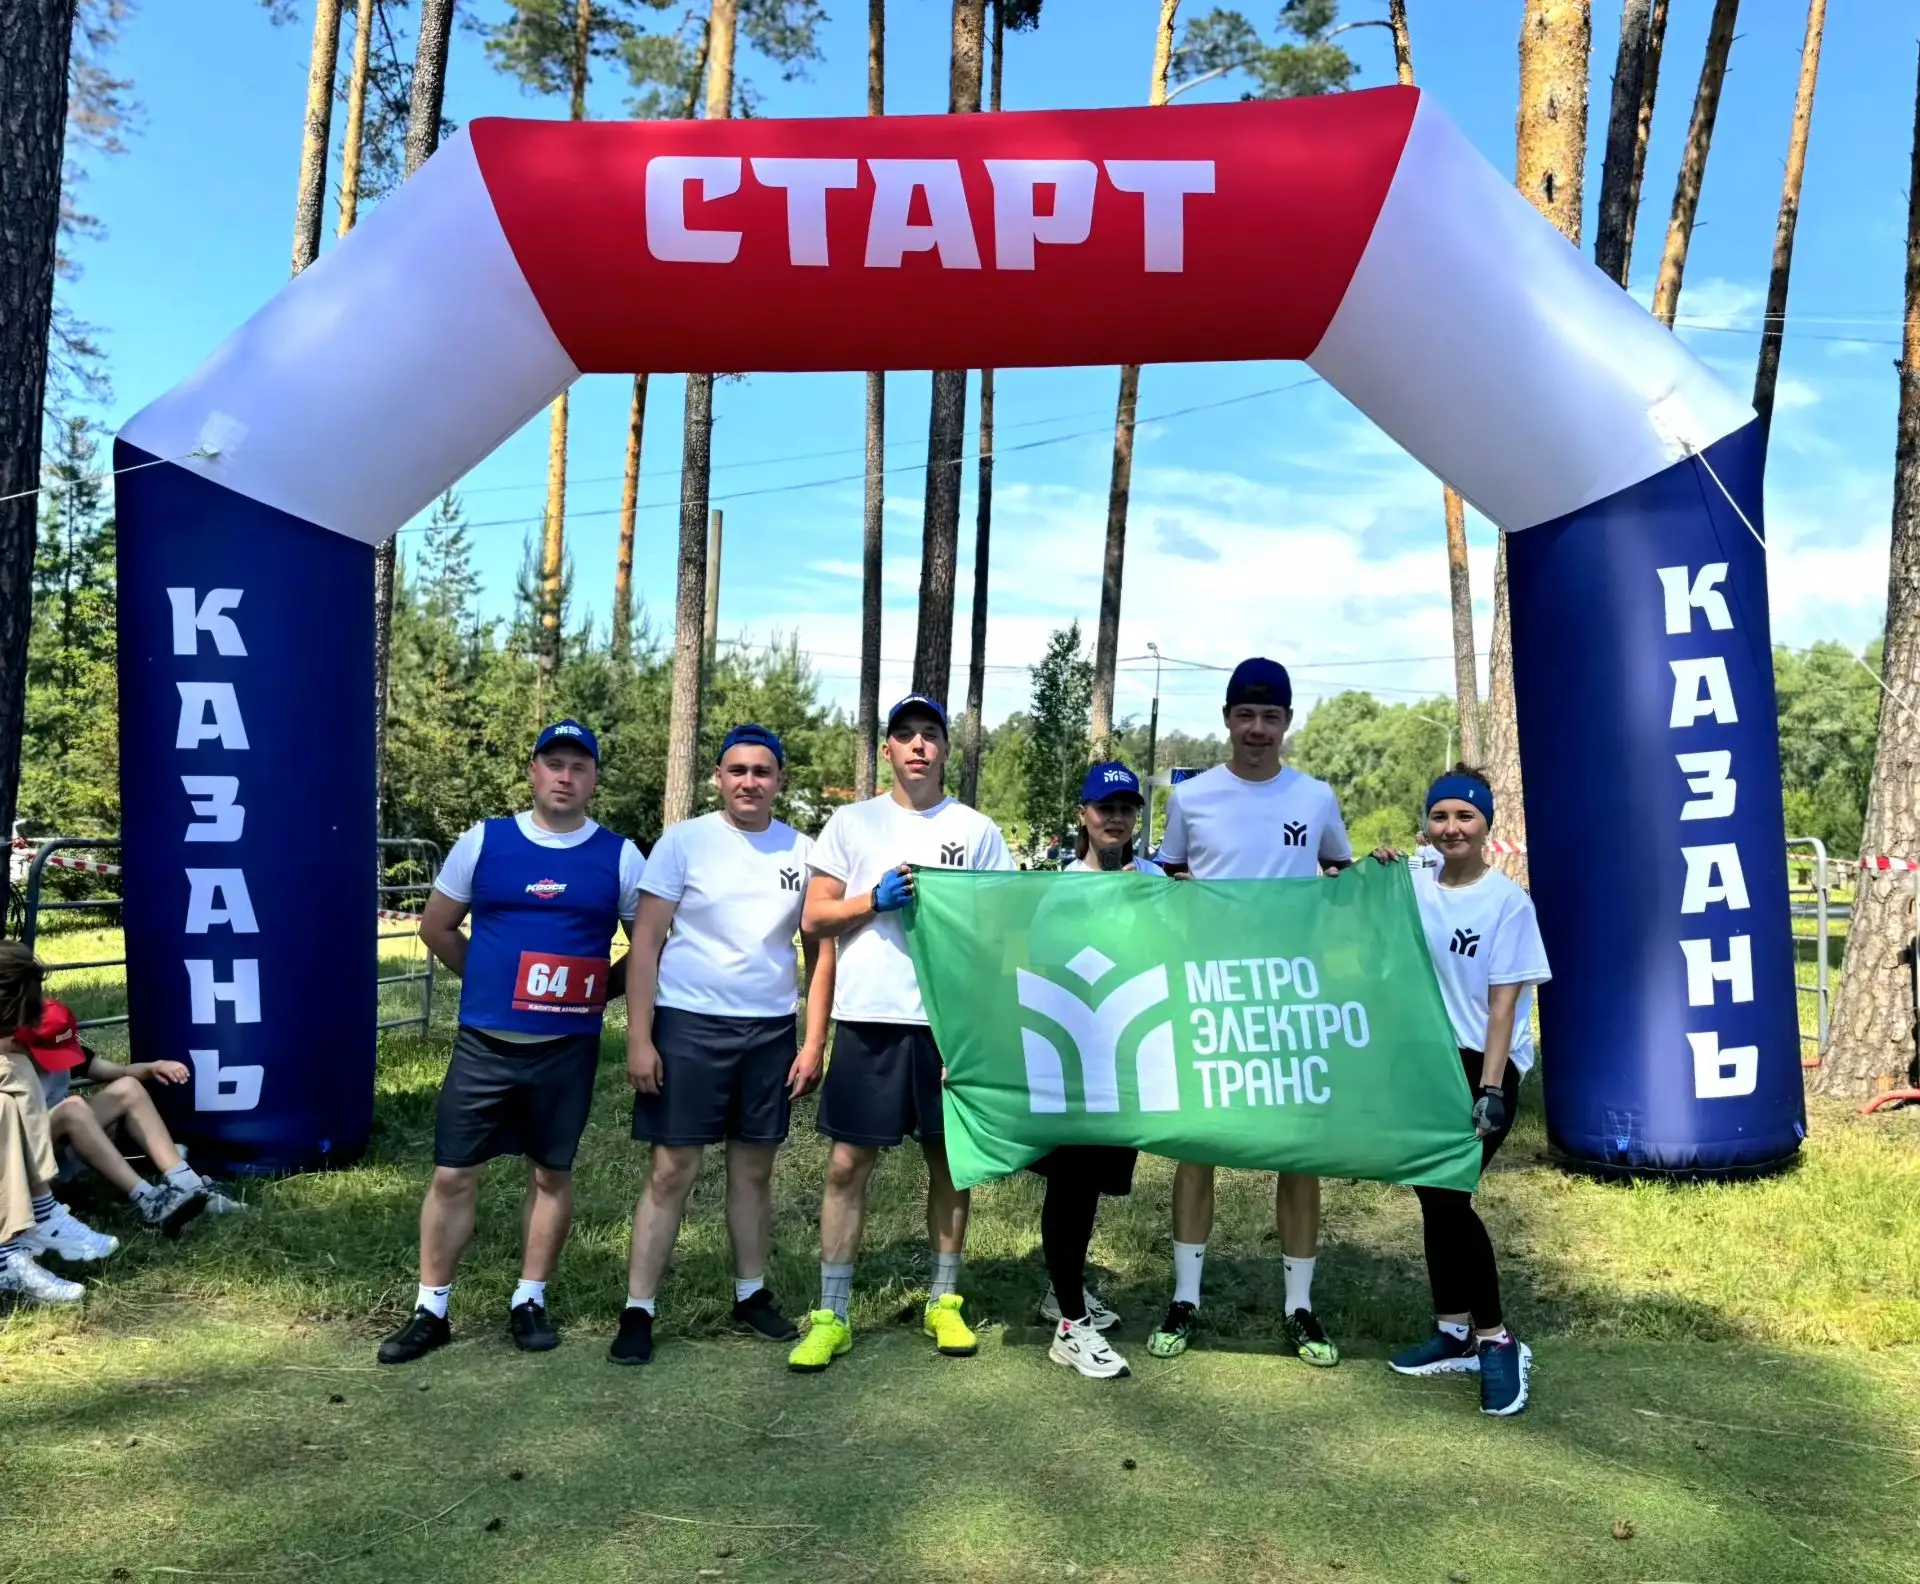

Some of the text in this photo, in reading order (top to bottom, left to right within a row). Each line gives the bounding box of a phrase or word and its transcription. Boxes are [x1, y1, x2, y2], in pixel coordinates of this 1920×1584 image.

[645, 156, 1215, 272] СТАРТ
[166, 587, 264, 1112] КАЗАНЬ
[1656, 562, 1759, 1099] КАЗАНЬ
[526, 963, 595, 999] 64 1
[1184, 957, 1319, 1003] МЕТРО
[1190, 1001, 1370, 1055] ЭЛЕКТРО
[1192, 1055, 1331, 1108] ТРАНС
